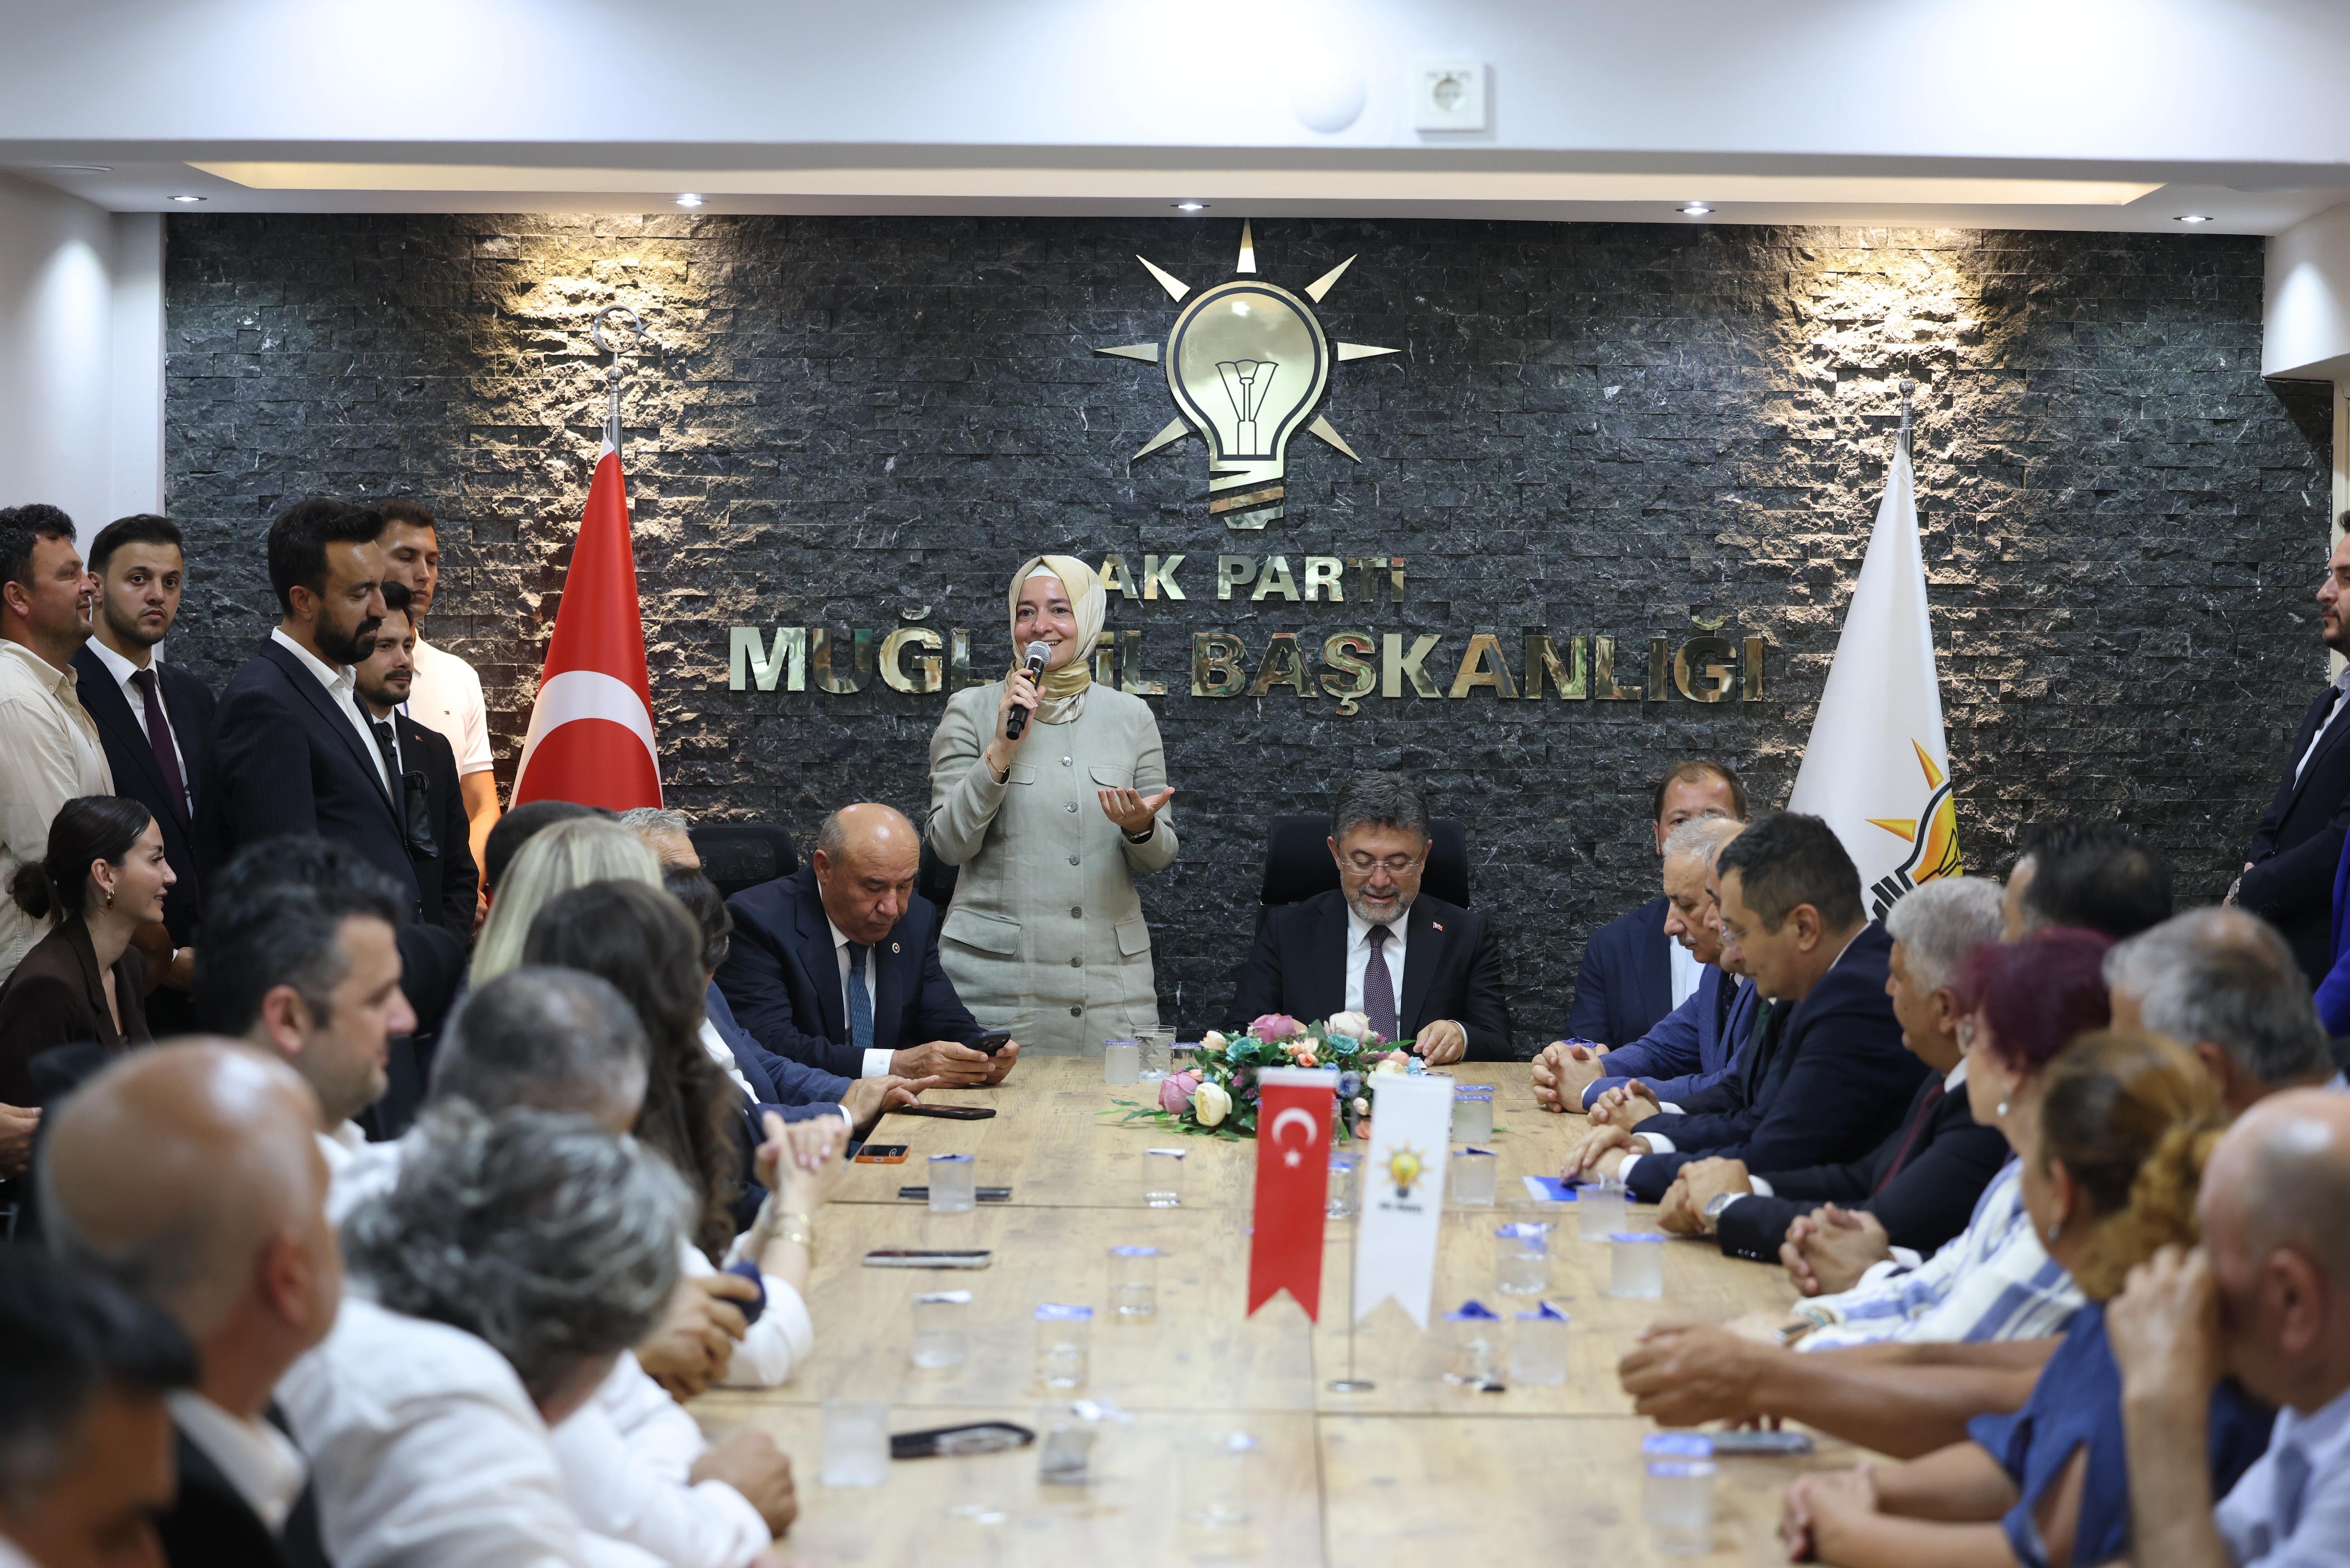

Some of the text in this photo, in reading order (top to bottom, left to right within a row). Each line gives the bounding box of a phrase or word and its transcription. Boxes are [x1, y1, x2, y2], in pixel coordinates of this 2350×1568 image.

[1098, 554, 1186, 599] AK
[729, 605, 997, 694] MUĞL
[1191, 616, 1762, 716] BAŞKANLIĞI
